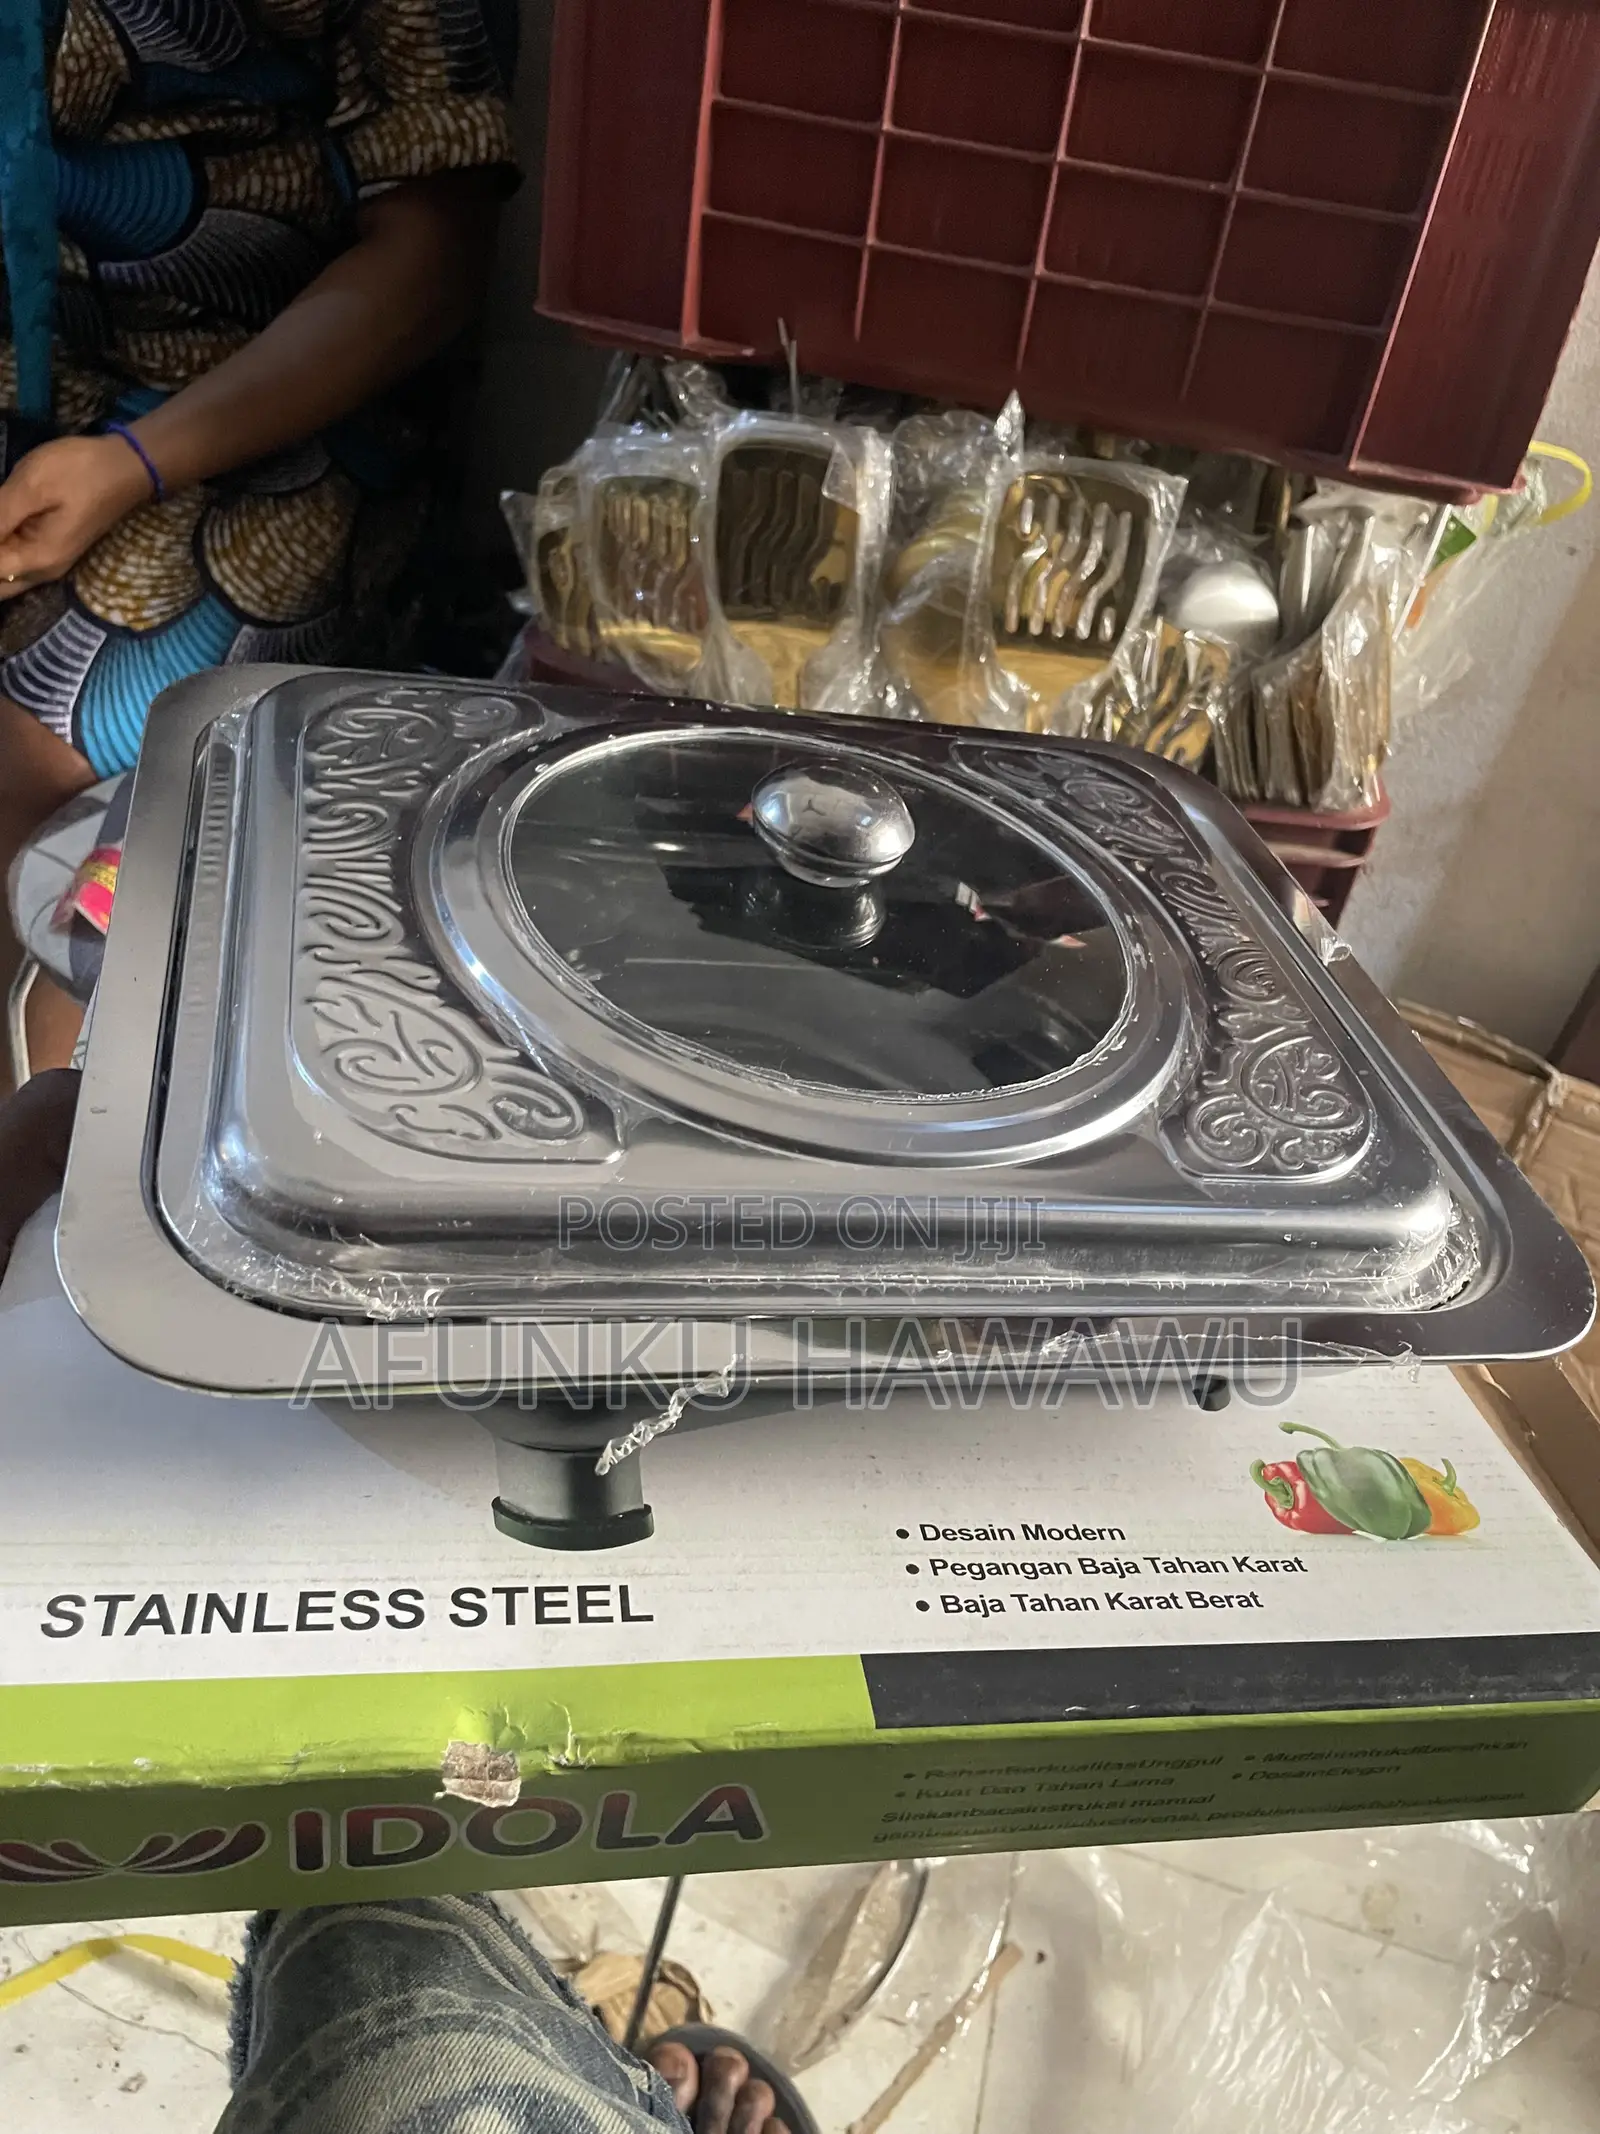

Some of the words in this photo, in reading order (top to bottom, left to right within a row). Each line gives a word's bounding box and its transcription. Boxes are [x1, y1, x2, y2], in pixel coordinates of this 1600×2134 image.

[919, 1523, 1015, 1541] Desain
[1020, 1523, 1126, 1541] Modern
[929, 1557, 1072, 1580] Pegangan
[1077, 1557, 1140, 1579] Baja
[1143, 1556, 1229, 1575] Tahan
[1234, 1555, 1308, 1574] Karat
[40, 1588, 425, 1638] STAINLESS
[448, 1583, 655, 1628] STEEL
[940, 1594, 1005, 1618] Baja
[1010, 1593, 1099, 1613] Tahan
[1103, 1591, 1184, 1612] Karat
[1187, 1590, 1264, 1609] Berat
[291, 1783, 769, 1873] IDOLA
